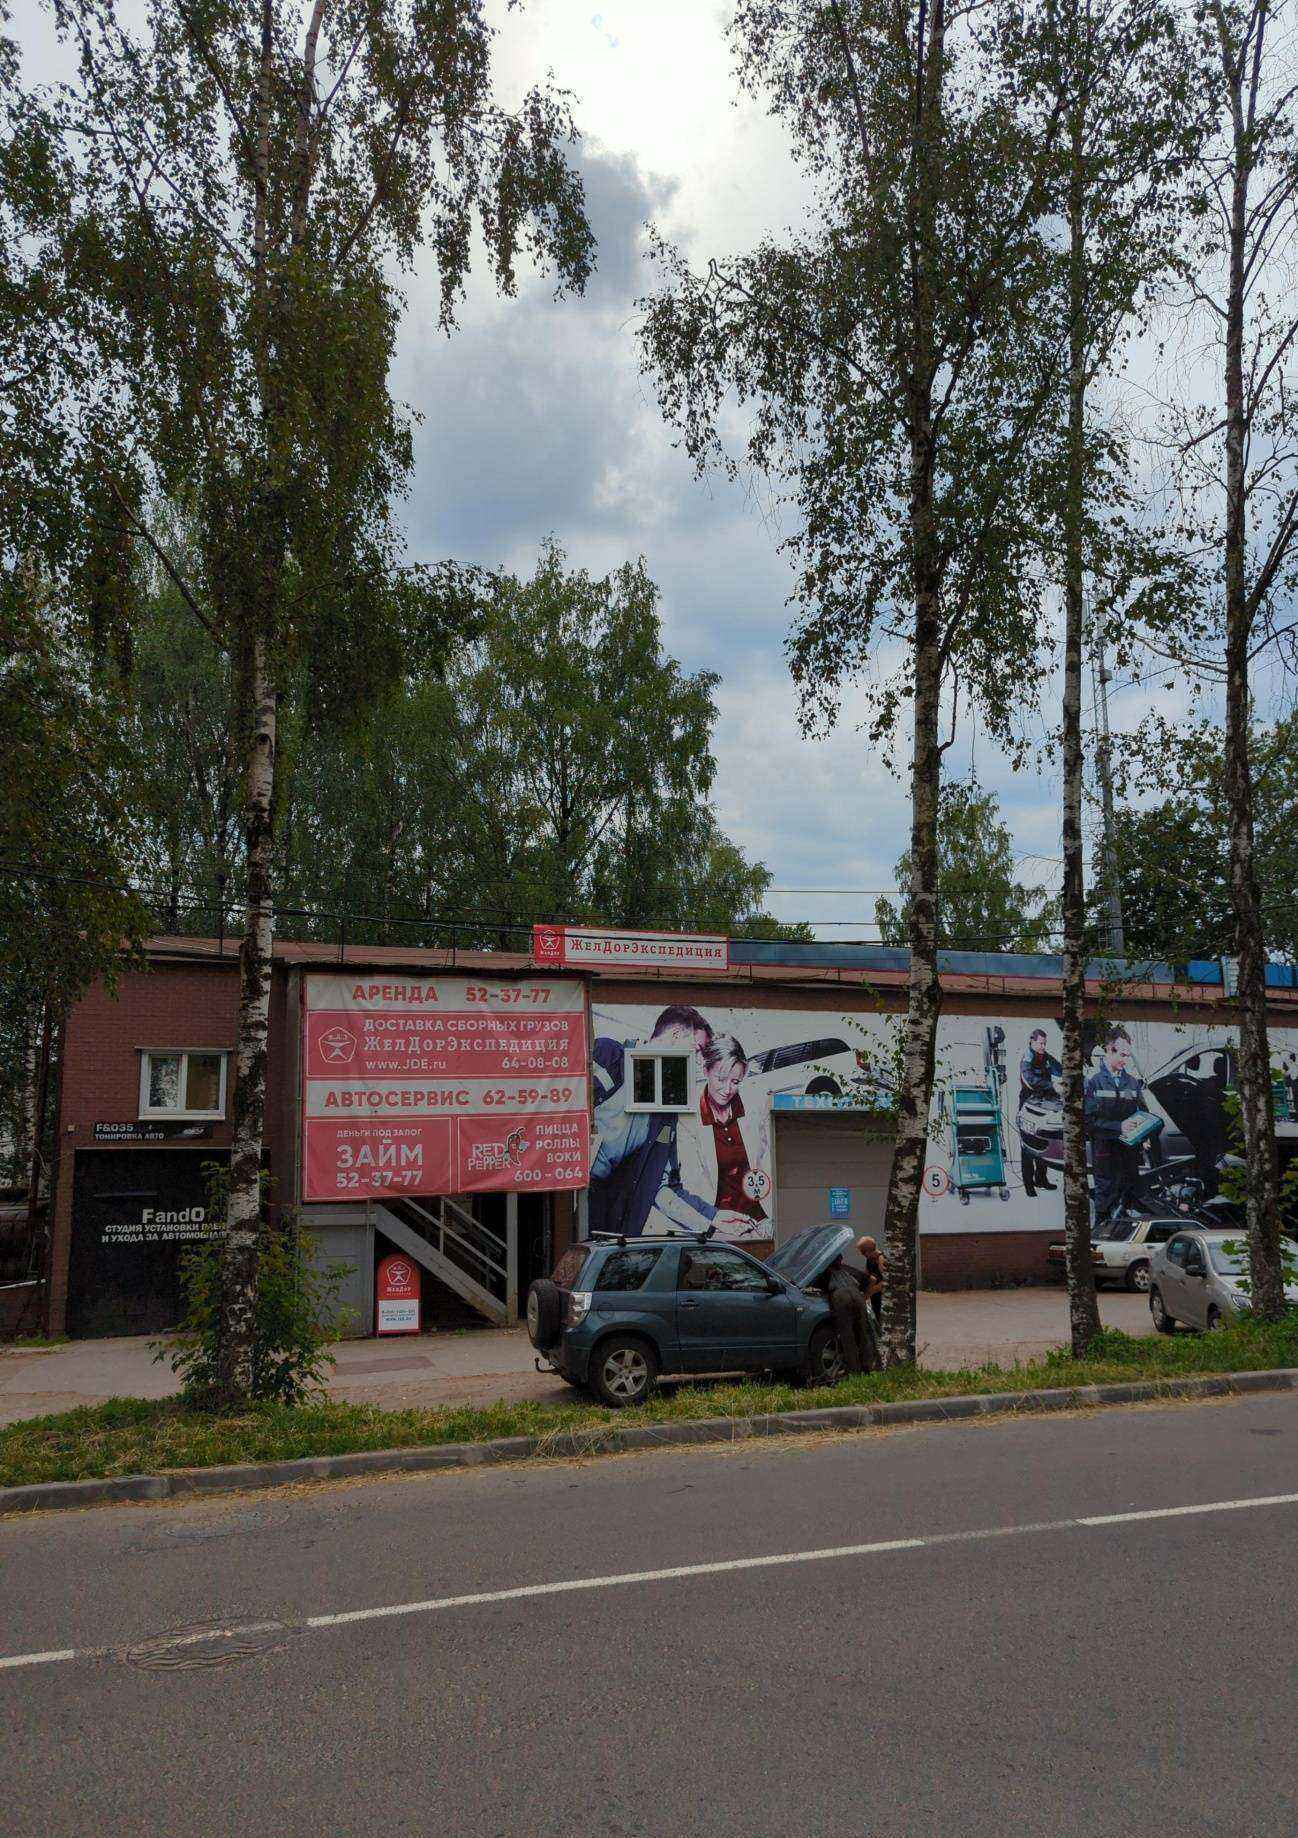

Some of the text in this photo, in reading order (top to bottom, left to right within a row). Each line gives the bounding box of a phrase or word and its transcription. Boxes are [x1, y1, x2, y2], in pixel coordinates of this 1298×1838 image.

[352, 984, 551, 1004] АРЕНДА 52-37-77
[363, 1019, 568, 1032] ДОСТАВКА СБОРНЫХ ГРУЗОВ
[366, 1058, 446, 1070] www.JDE.ru
[502, 1057, 568, 1069] 64-08-08
[324, 1088, 572, 1107] АВТОСЕРВИС 62-59-89
[336, 1129, 422, 1138] ДЕНЬГИ ПОД ЗАЛОГ
[536, 1123, 579, 1136] ПИЦЦА
[95, 1132, 165, 1141] ТОНИРОВКА АВТО
[472, 1143, 505, 1158] RED
[536, 1139, 580, 1150] РОЛЛЫ
[336, 1139, 423, 1168] ЗАЙМ
[546, 1152, 581, 1163] ВОКИ
[336, 1170, 423, 1188] 52-37-77
[932, 1173, 940, 1187] 5
[142, 1206, 205, 1223] FandO
[105, 1224, 142, 1233] СТУДИЯ
[144, 1222, 199, 1232] УСТАНОВКИ
[101, 1234, 109, 1243] И
[111, 1233, 144, 1243] УХОДА
[146, 1232, 159, 1241] ЗА
